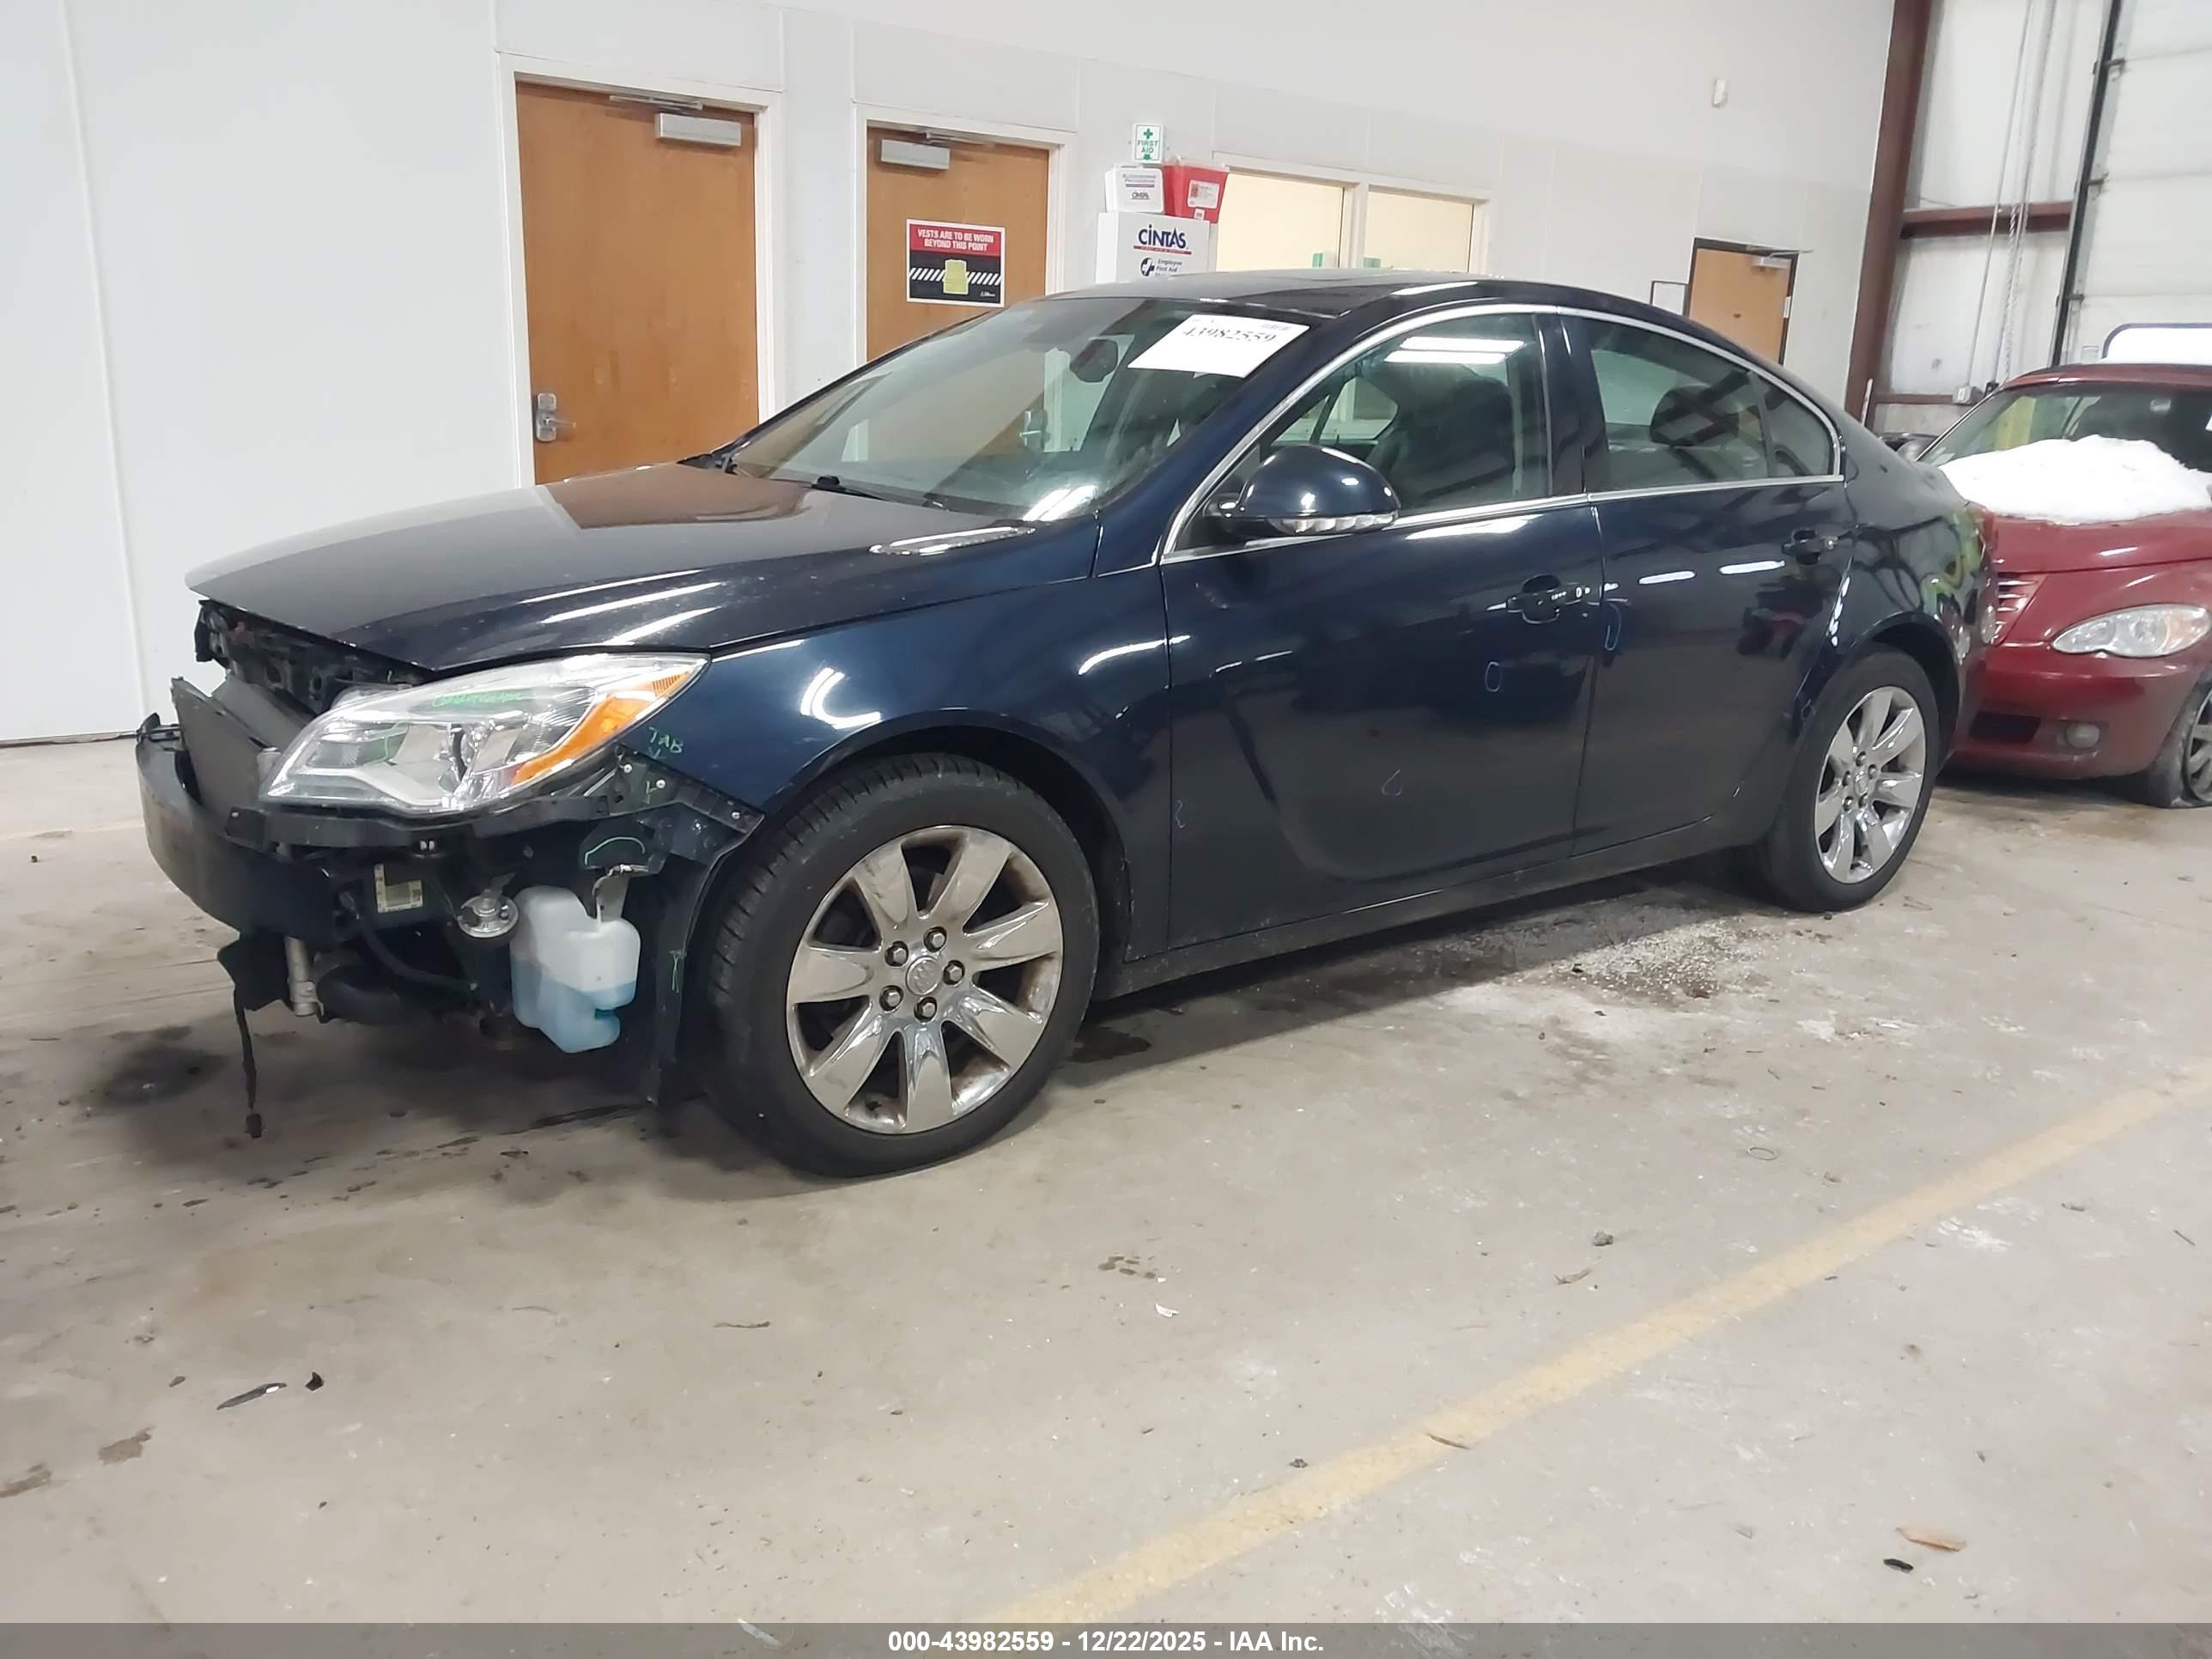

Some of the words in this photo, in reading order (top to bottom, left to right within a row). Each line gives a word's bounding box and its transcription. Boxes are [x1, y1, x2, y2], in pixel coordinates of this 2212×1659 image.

[917, 228, 939, 239] VESTS
[939, 231, 952, 240] ARE
[954, 232, 963, 240] TO
[963, 233, 973, 241] BE
[974, 234, 994, 243] WORN
[924, 239, 951, 249] BEYOND
[952, 240, 967, 249] THIS
[968, 241, 988, 252] POINT
[1182, 326, 1277, 342] 43982559
